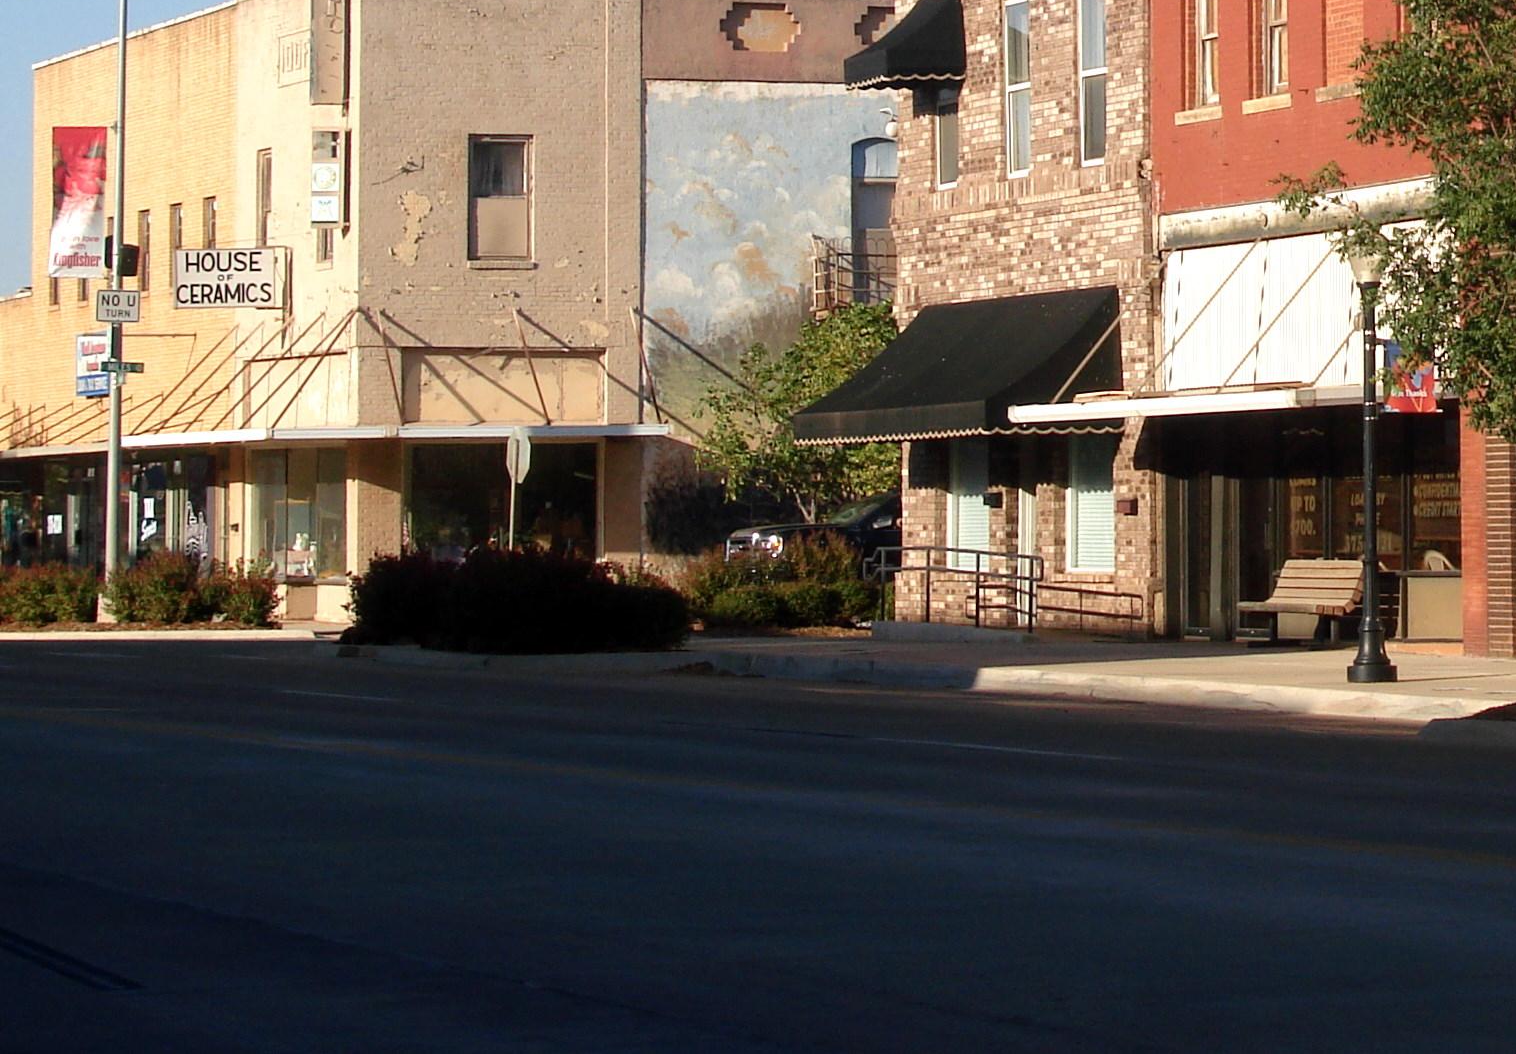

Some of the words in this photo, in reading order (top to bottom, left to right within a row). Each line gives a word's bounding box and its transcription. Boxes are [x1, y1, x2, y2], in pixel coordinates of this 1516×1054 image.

[185, 251, 263, 273] HOUSE
[101, 294, 120, 307] NO
[127, 294, 136, 307] U
[176, 282, 272, 304] CERAMICS
[105, 309, 131, 318] TURN
[1303, 494, 1316, 512] TO
